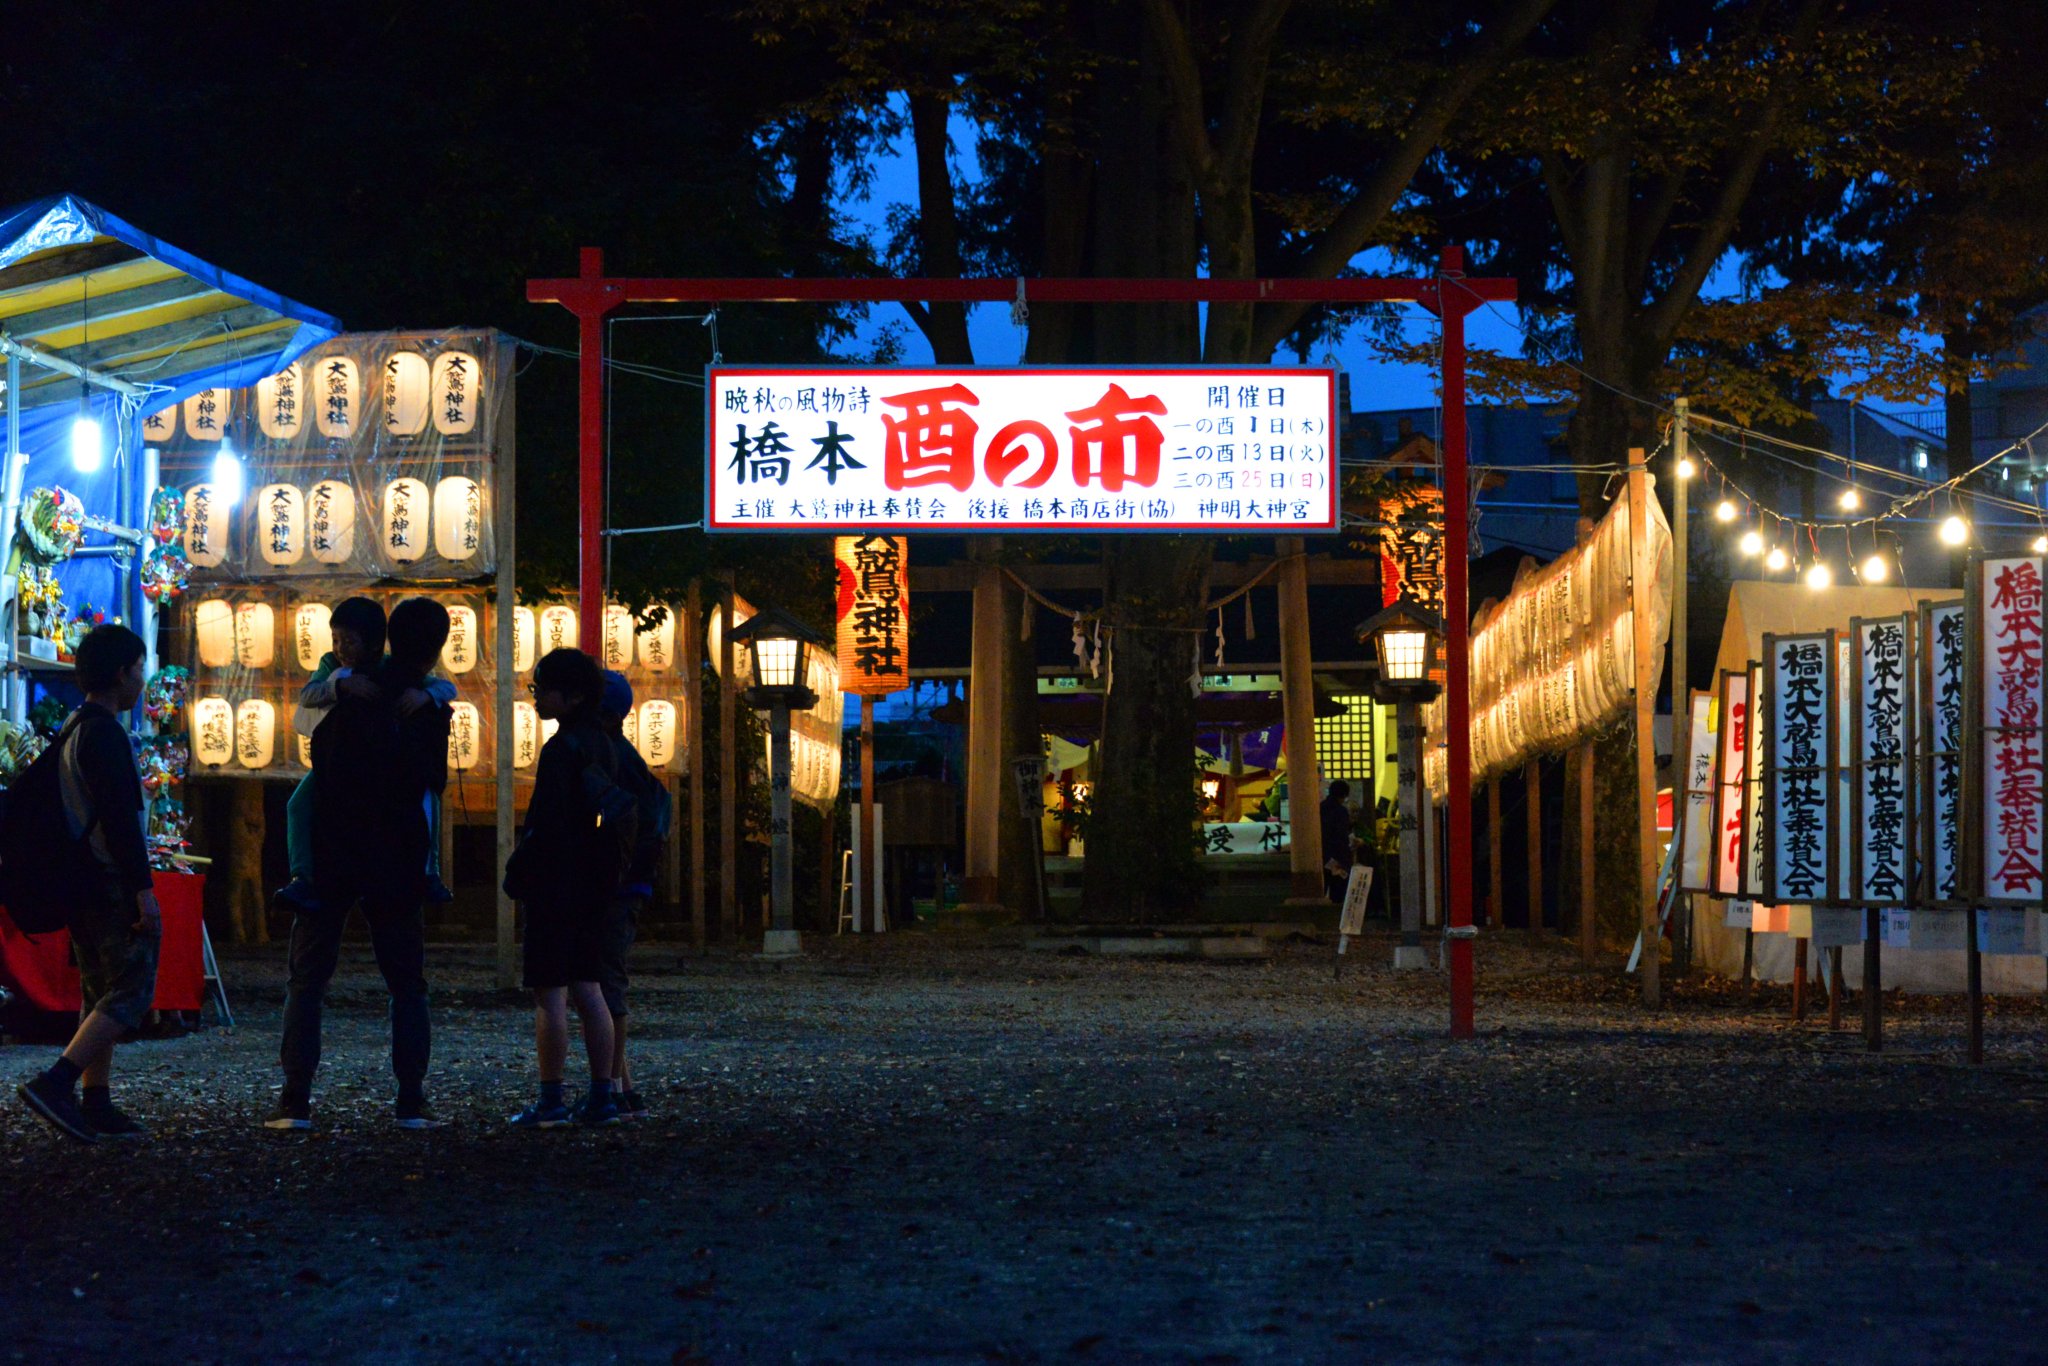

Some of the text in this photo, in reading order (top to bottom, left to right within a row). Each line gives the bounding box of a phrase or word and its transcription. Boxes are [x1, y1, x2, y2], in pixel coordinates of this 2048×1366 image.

[724, 386, 872, 414] 晩秋の風物詩
[880, 382, 1168, 493] 酉の市
[1207, 385, 1286, 410] 開催日
[727, 420, 868, 486] 橋本
[731, 498, 775, 519] 主催
[967, 498, 1011, 520] 後援
[1198, 498, 1311, 521] 神明大神宮
[1780, 643, 1824, 899] 橋本大鷲神社奉賛会
[1865, 624, 1904, 900] 橋本大鷲神社奉賛会
[1990, 561, 2043, 894] 橋本大鷲神社奉賛会
